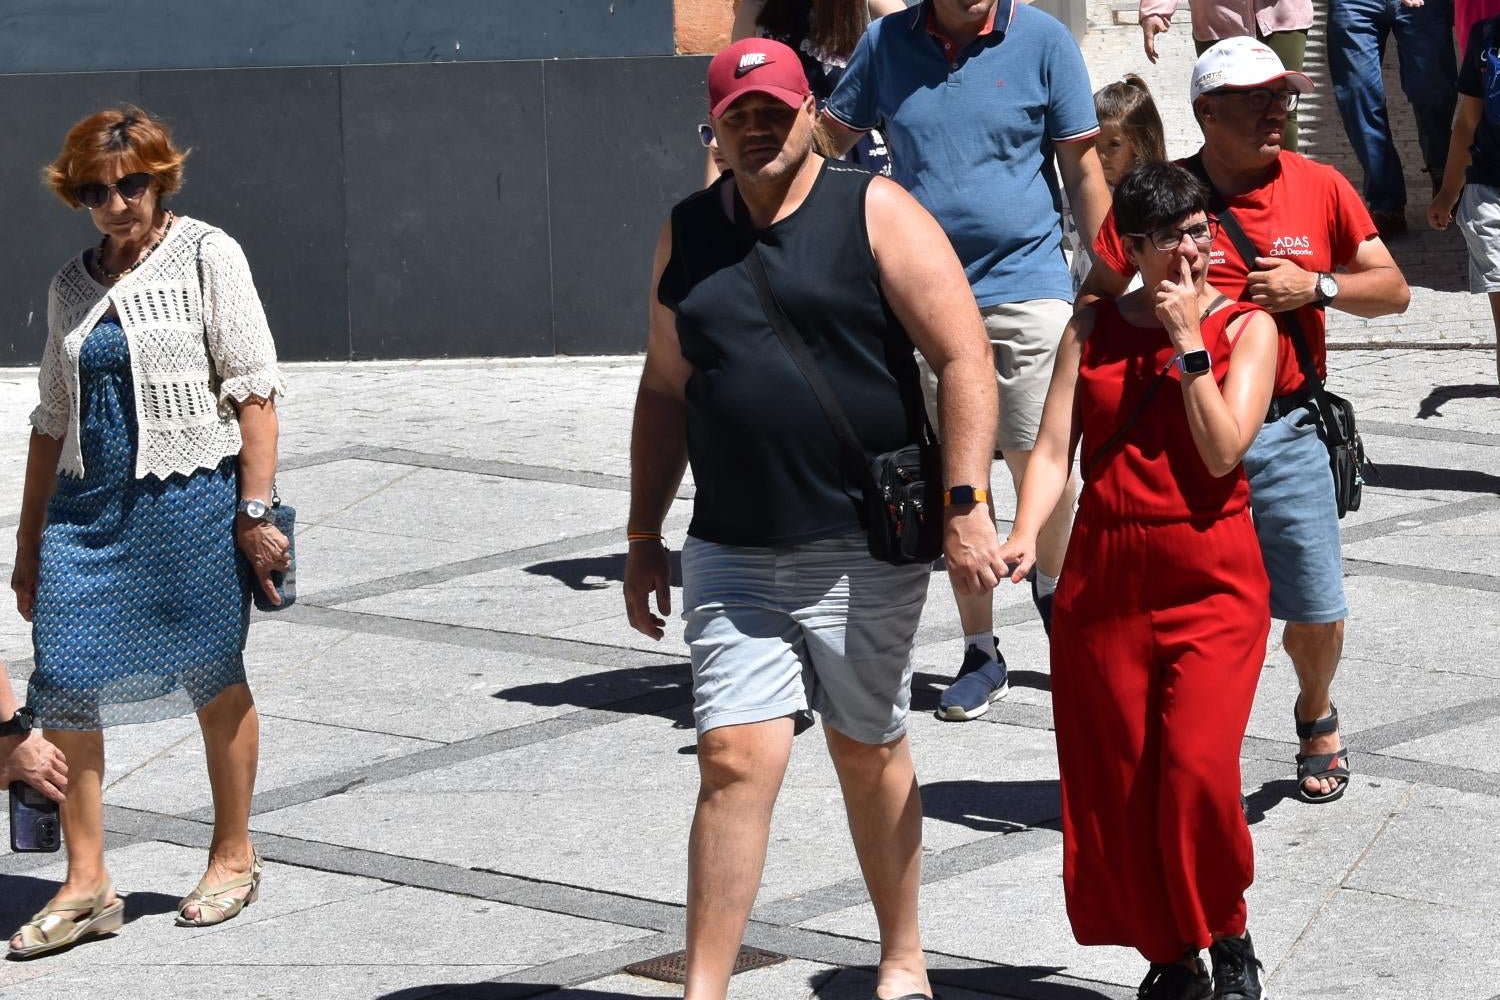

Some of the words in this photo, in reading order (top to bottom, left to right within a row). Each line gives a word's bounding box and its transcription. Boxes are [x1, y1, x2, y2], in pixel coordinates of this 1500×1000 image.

[740, 54, 767, 67] NIKE
[1273, 236, 1310, 248] ADAS
[1269, 248, 1286, 256] Club
